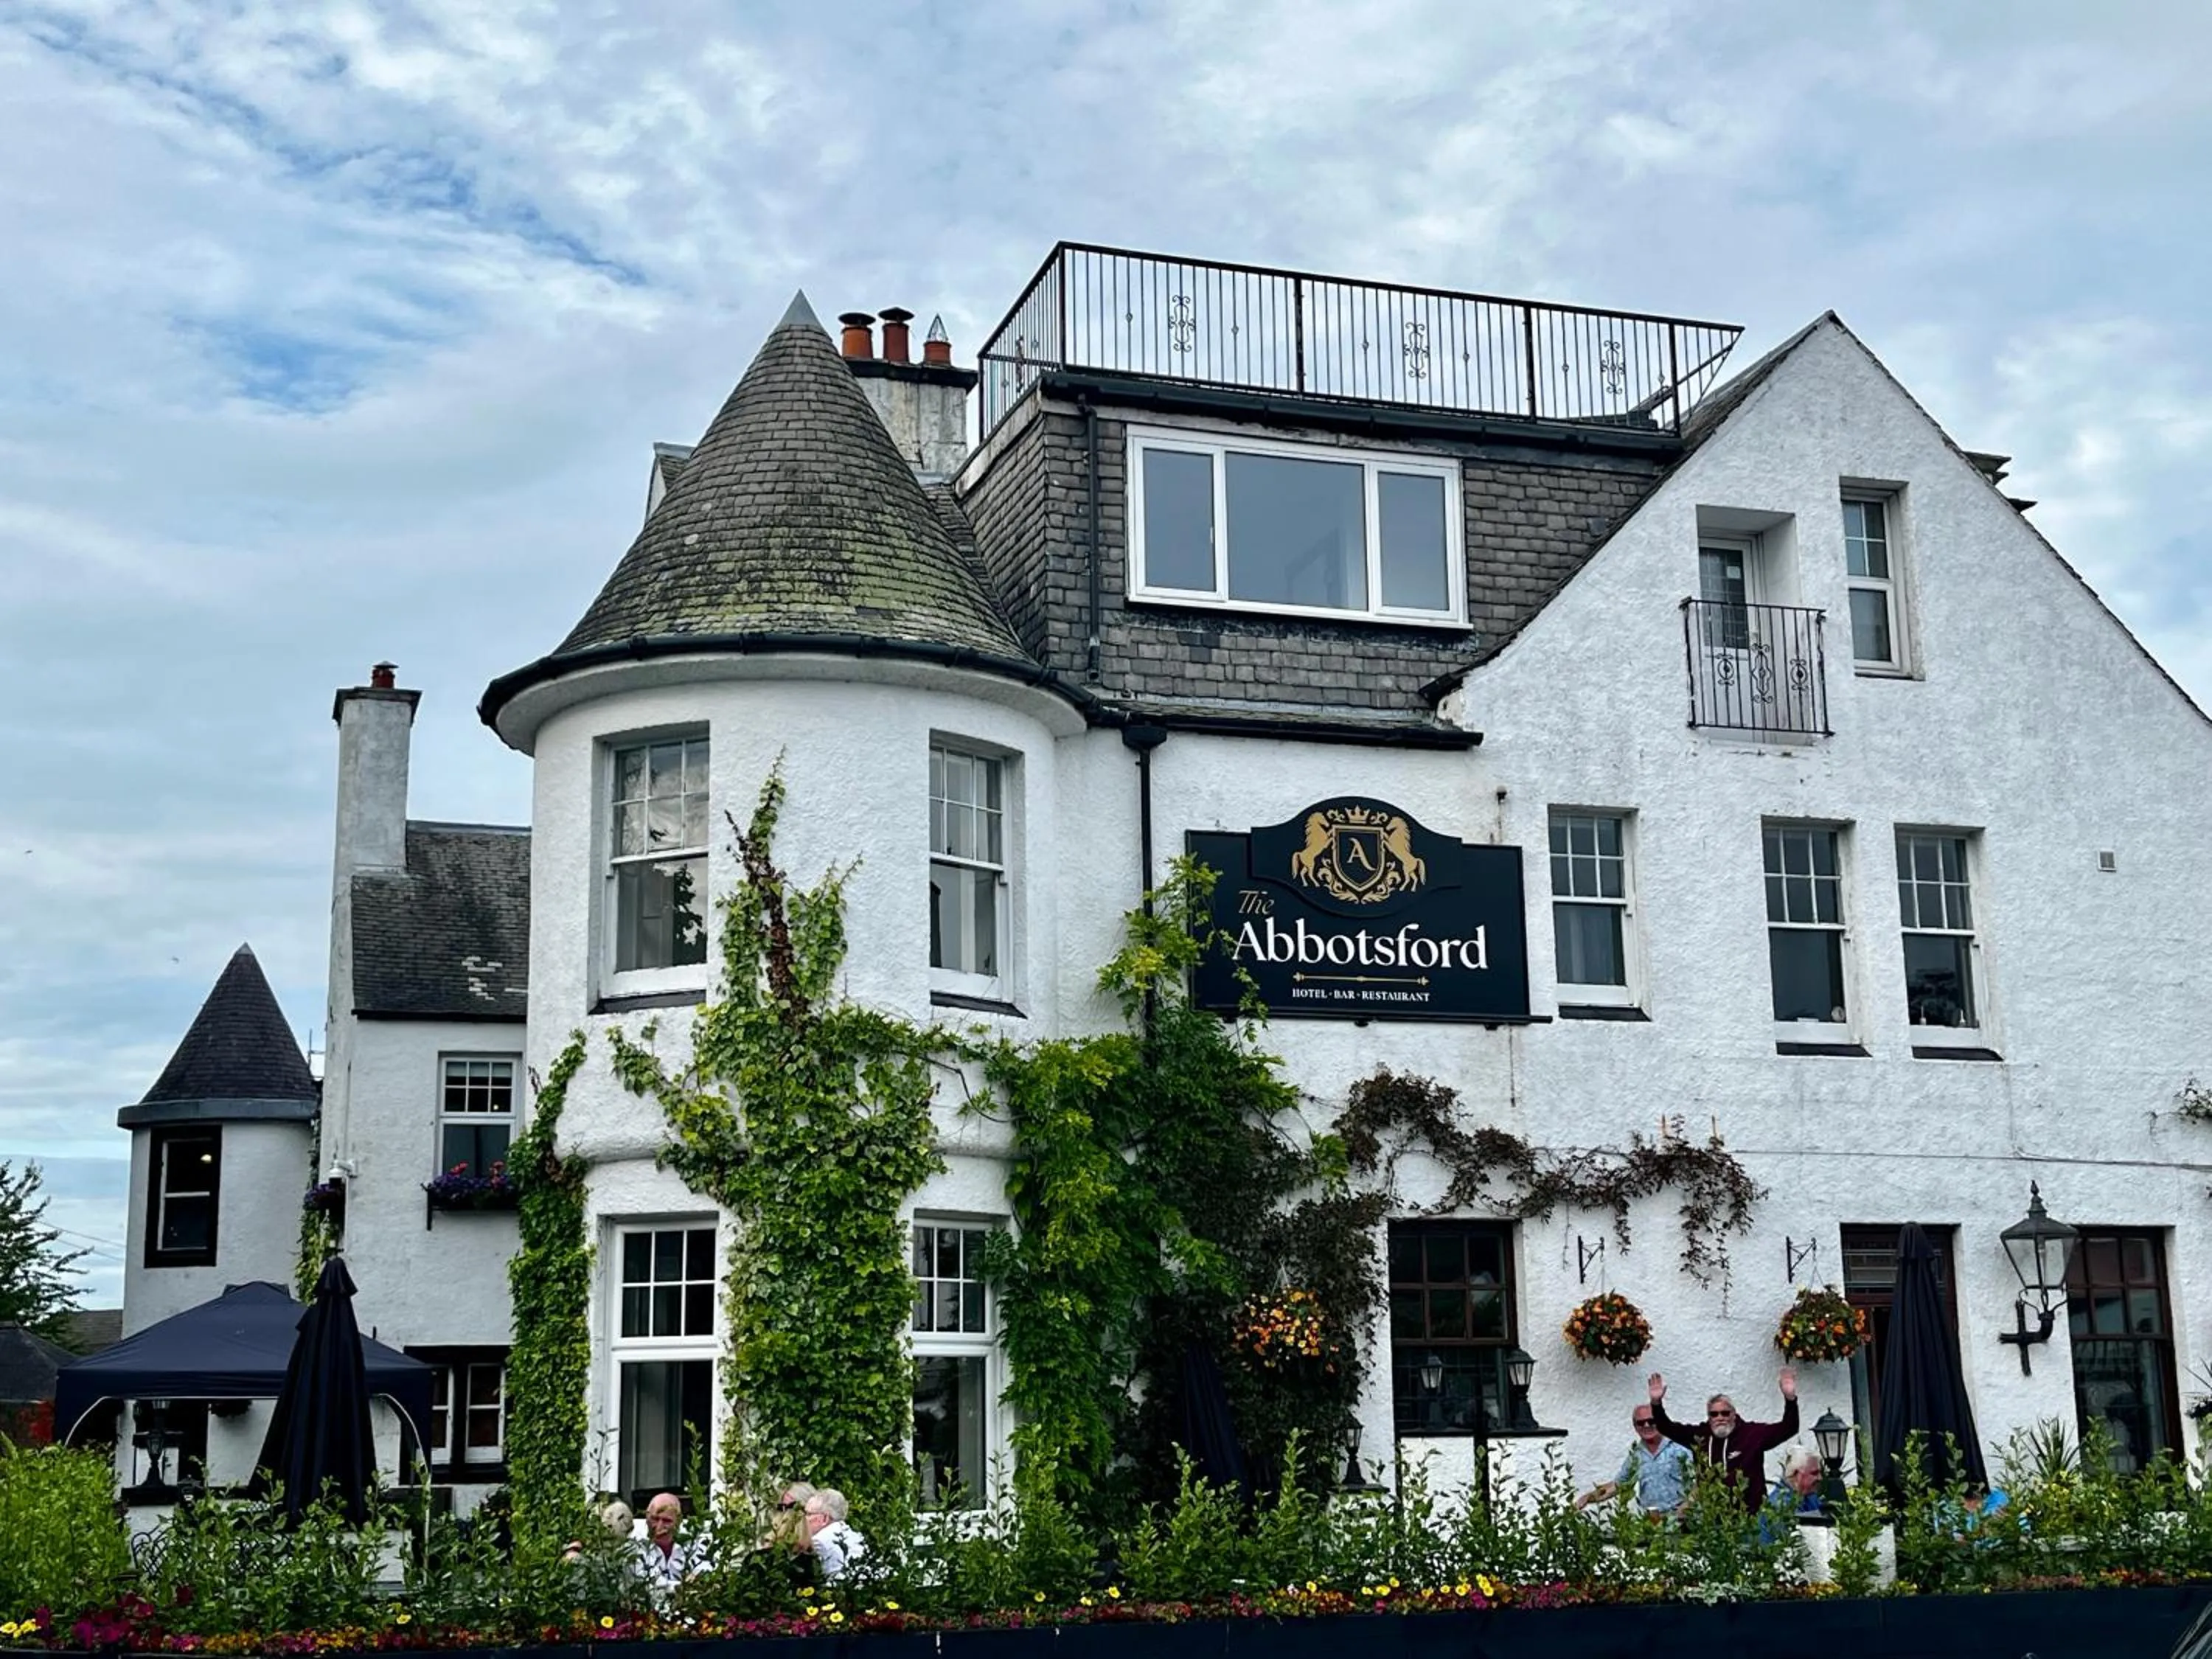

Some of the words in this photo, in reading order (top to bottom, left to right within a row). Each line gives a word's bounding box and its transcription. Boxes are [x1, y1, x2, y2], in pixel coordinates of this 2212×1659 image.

[1346, 837, 1377, 871] A
[1238, 890, 1274, 915] The
[1232, 917, 1488, 970] Abbotsford
[1292, 987, 1327, 999] HOTEL
[1334, 990, 1355, 999] BAR
[1362, 990, 1430, 1002] RESTAURANT
